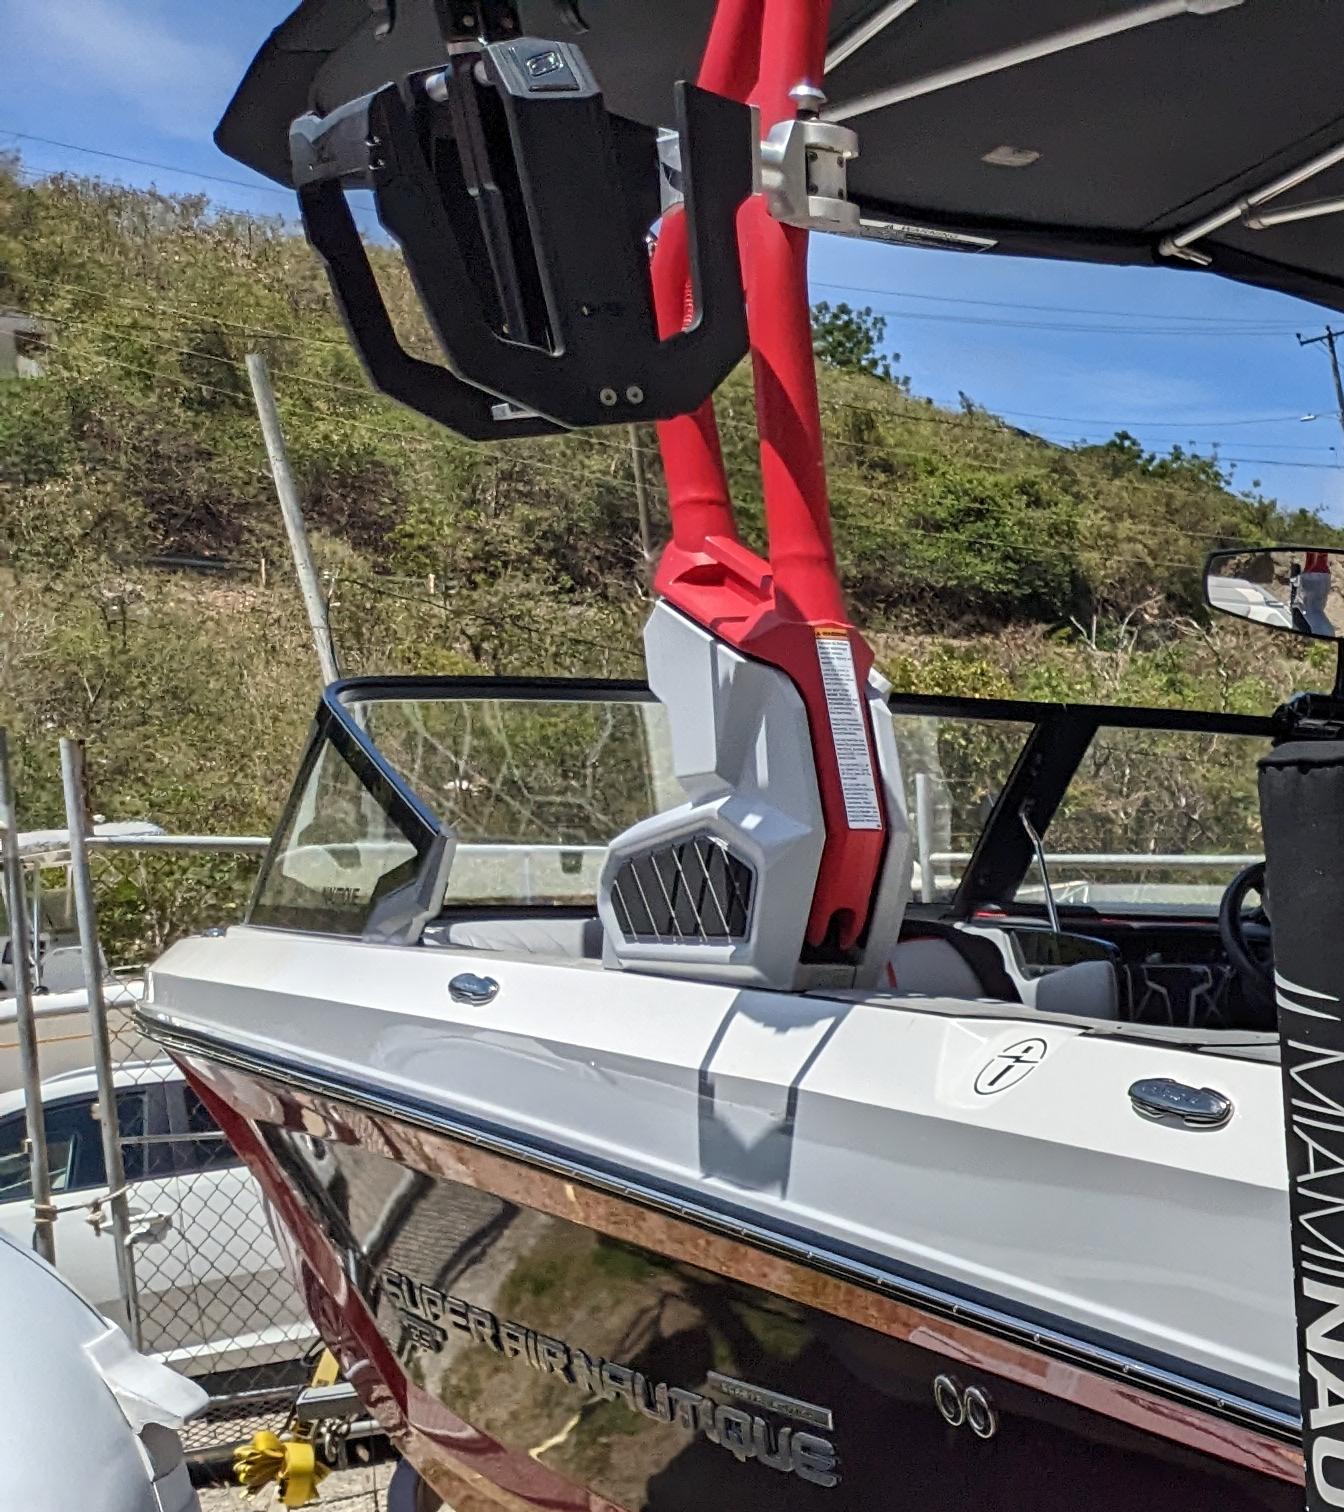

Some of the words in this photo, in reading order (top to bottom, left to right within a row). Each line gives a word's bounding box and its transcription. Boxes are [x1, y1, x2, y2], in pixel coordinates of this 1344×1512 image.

[381, 1267, 504, 1352] SUPER
[500, 1320, 574, 1383] AIR
[572, 1348, 842, 1487] NAUTIQUE
